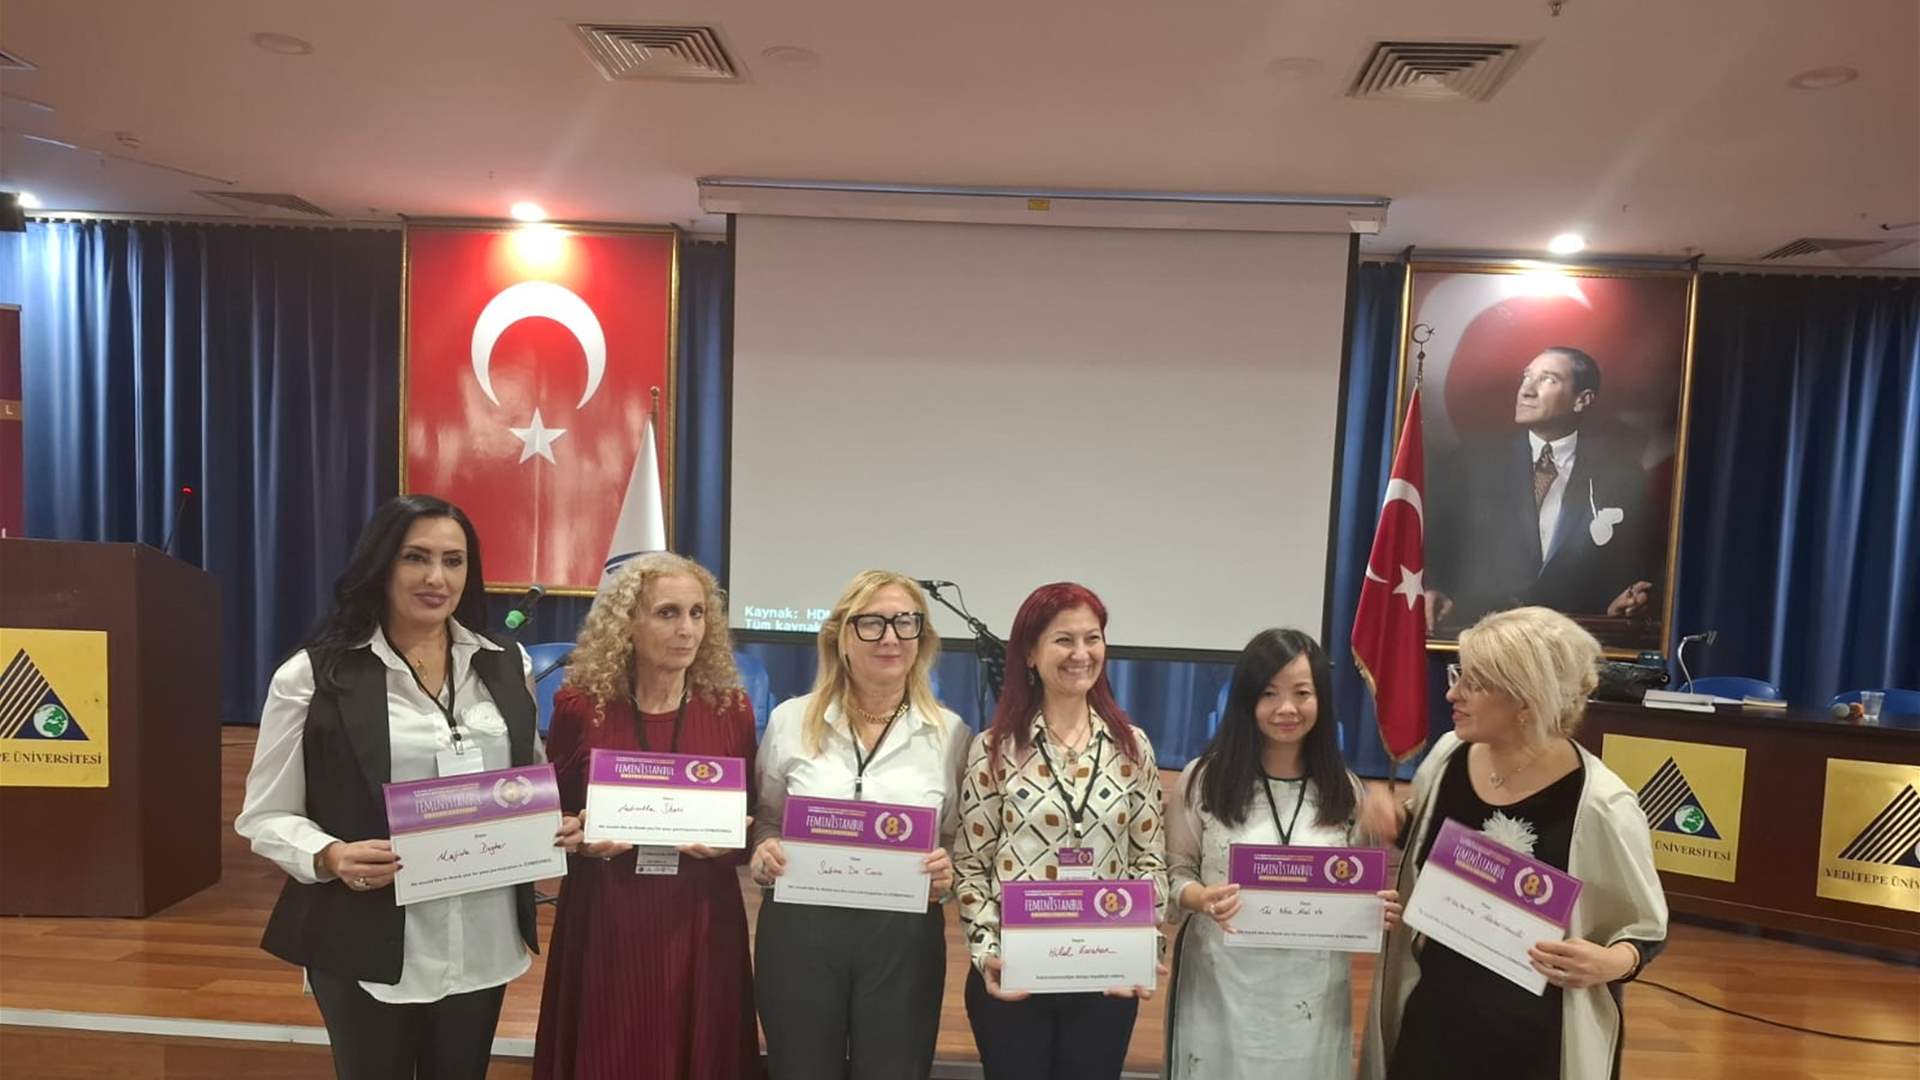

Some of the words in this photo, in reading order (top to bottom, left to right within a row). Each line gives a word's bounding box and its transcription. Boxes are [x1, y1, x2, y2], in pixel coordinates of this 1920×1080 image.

[744, 606, 798, 619] Kaynak:
[745, 619, 771, 629] Tüm
[13, 751, 102, 765] ÜNİVERSİTESİ
[885, 816, 899, 836] 8
[1335, 860, 1349, 879] 8
[1105, 892, 1119, 912] 8
